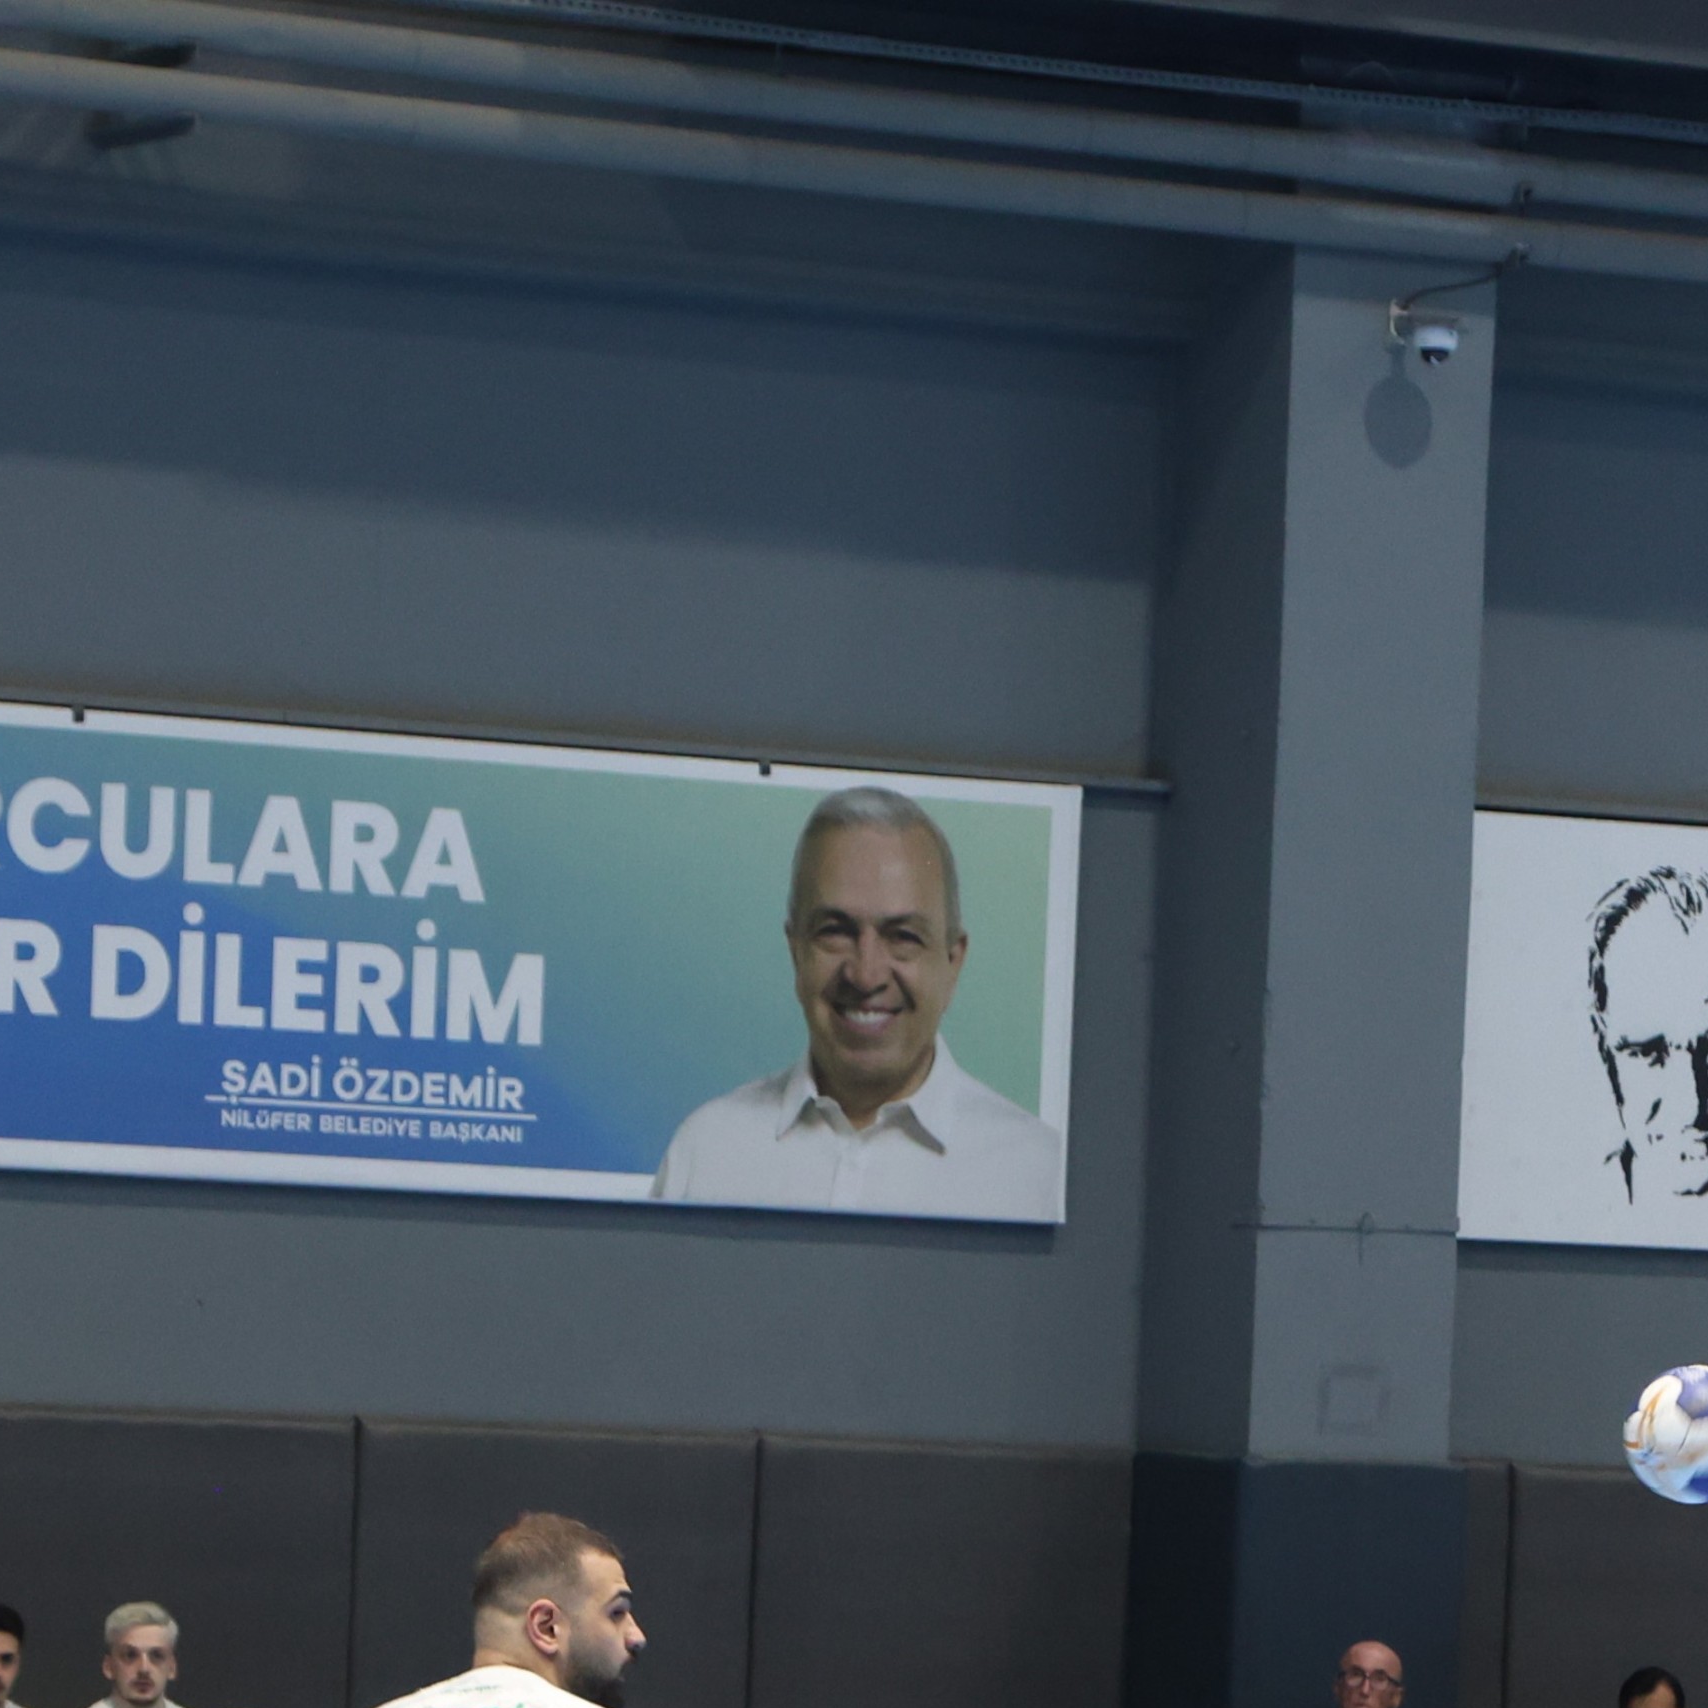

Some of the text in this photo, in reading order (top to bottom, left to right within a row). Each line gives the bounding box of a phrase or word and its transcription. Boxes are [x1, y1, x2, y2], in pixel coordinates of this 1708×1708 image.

[92, 903, 544, 1044] DİLERİM
[332, 1056, 525, 1111] ÖZDEMİR
[220, 1108, 524, 1144] NİLÜFER BELEDİYE BAŞKANI
